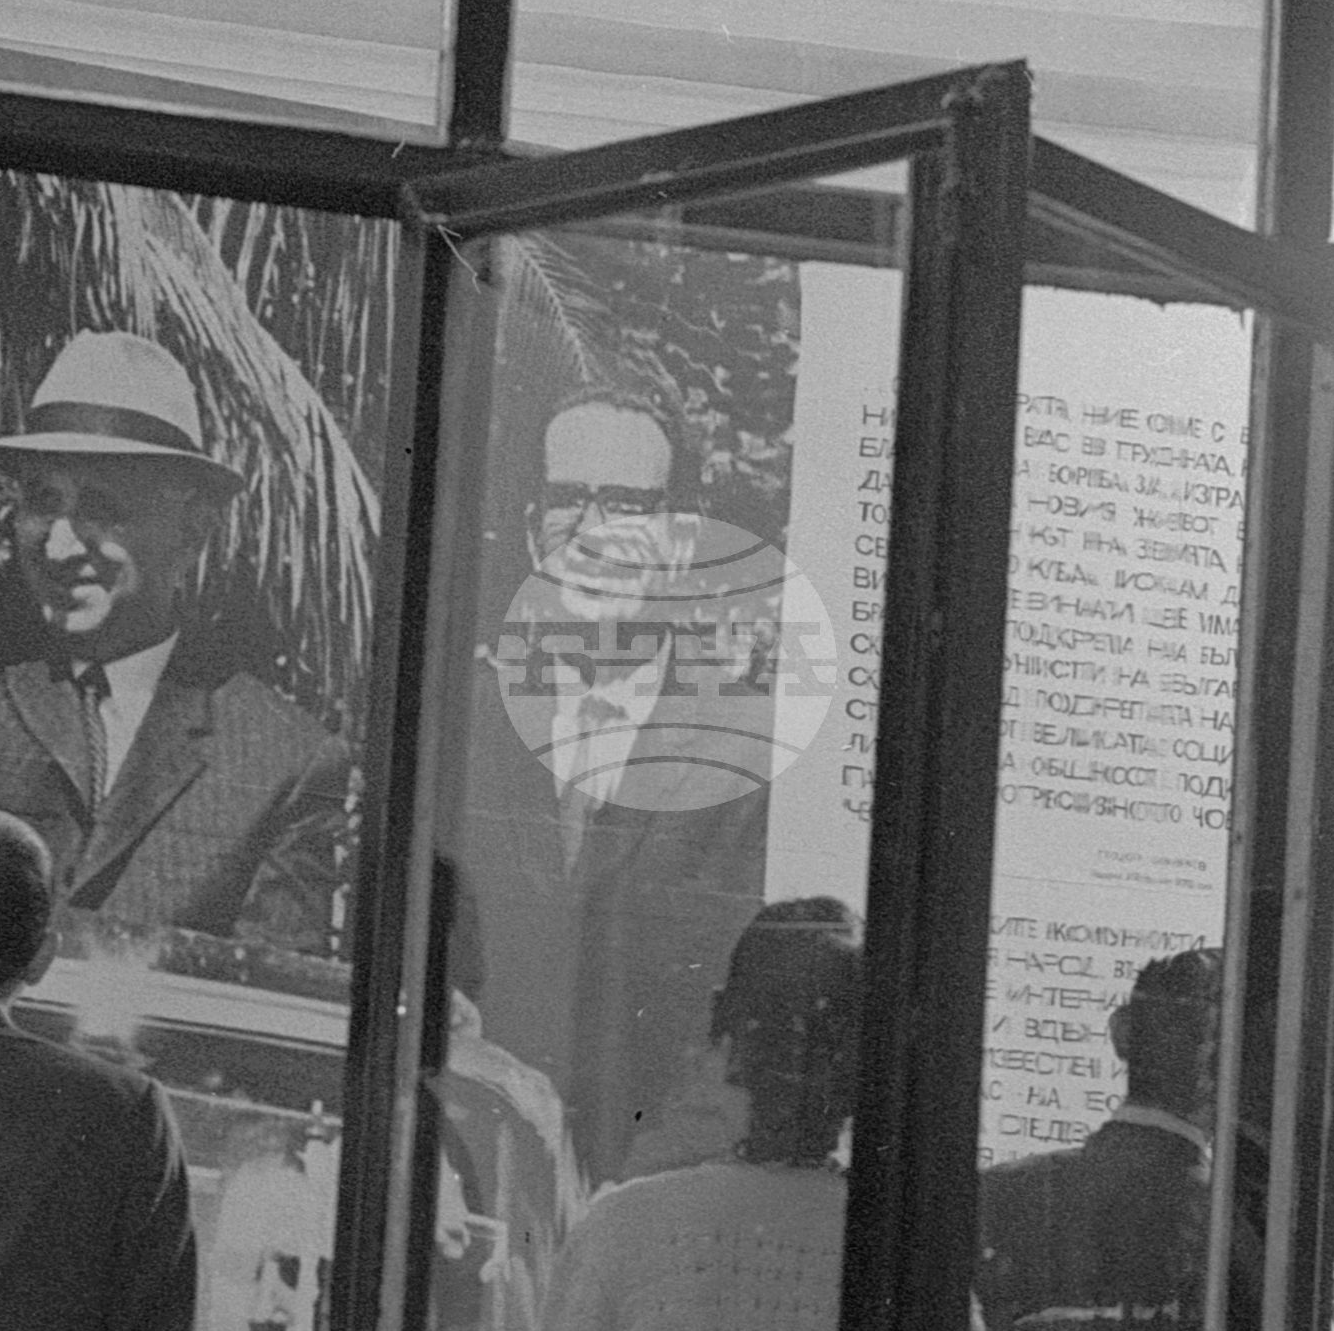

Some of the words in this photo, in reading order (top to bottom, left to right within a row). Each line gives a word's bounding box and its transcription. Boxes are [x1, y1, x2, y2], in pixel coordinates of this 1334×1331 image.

[1183, 481, 1244, 511] ИЗГРА
[1198, 611, 1240, 637] ИМА
[1200, 645, 1238, 667] БЪЛ
[1173, 738, 1235, 765] СОЦИ
